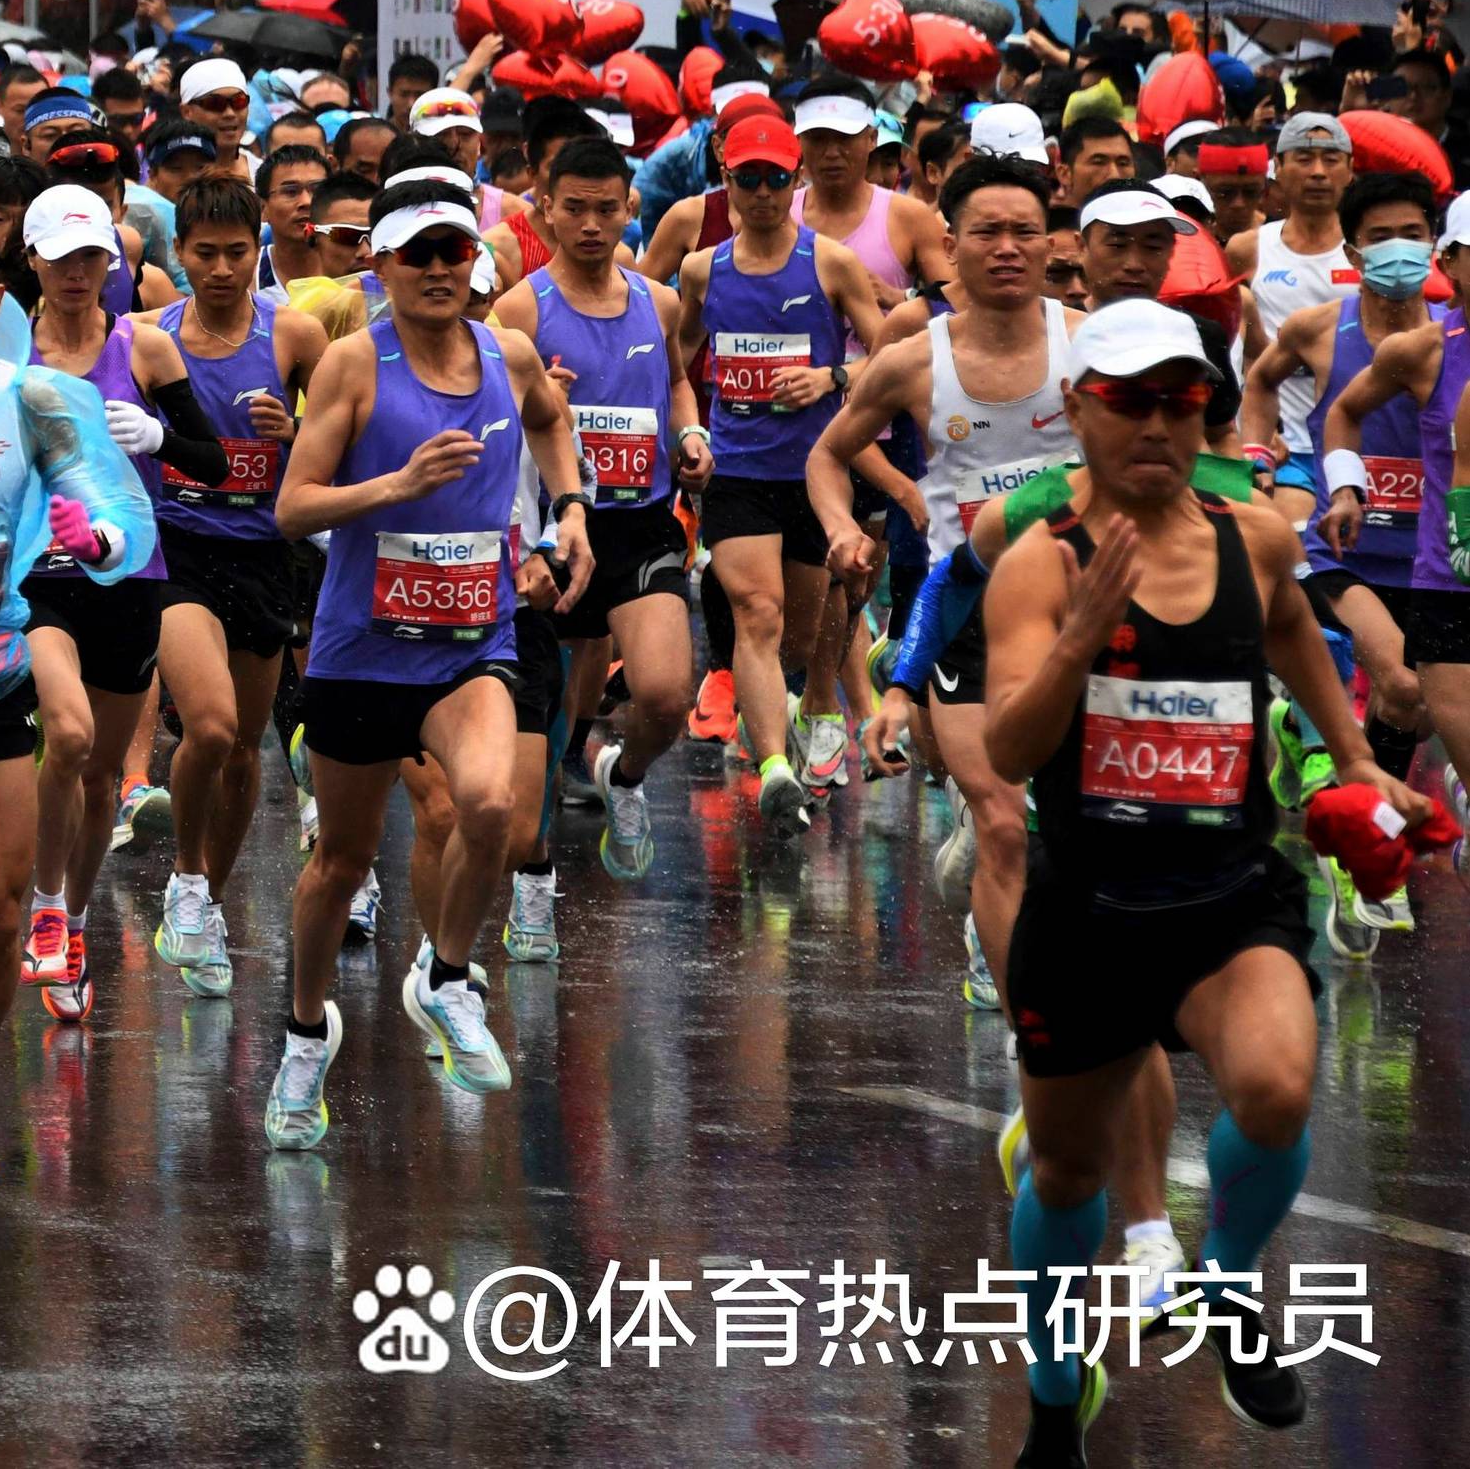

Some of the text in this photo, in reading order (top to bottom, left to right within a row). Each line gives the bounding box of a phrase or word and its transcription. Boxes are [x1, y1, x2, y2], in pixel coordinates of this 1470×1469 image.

[734, 338, 784, 353] Haier
[579, 412, 632, 429] Haier
[973, 420, 990, 430] NN
[413, 540, 474, 561] Haier
[385, 578, 492, 610] A5356
[1132, 690, 1218, 717] Haier
[1097, 738, 1241, 783] A0447
